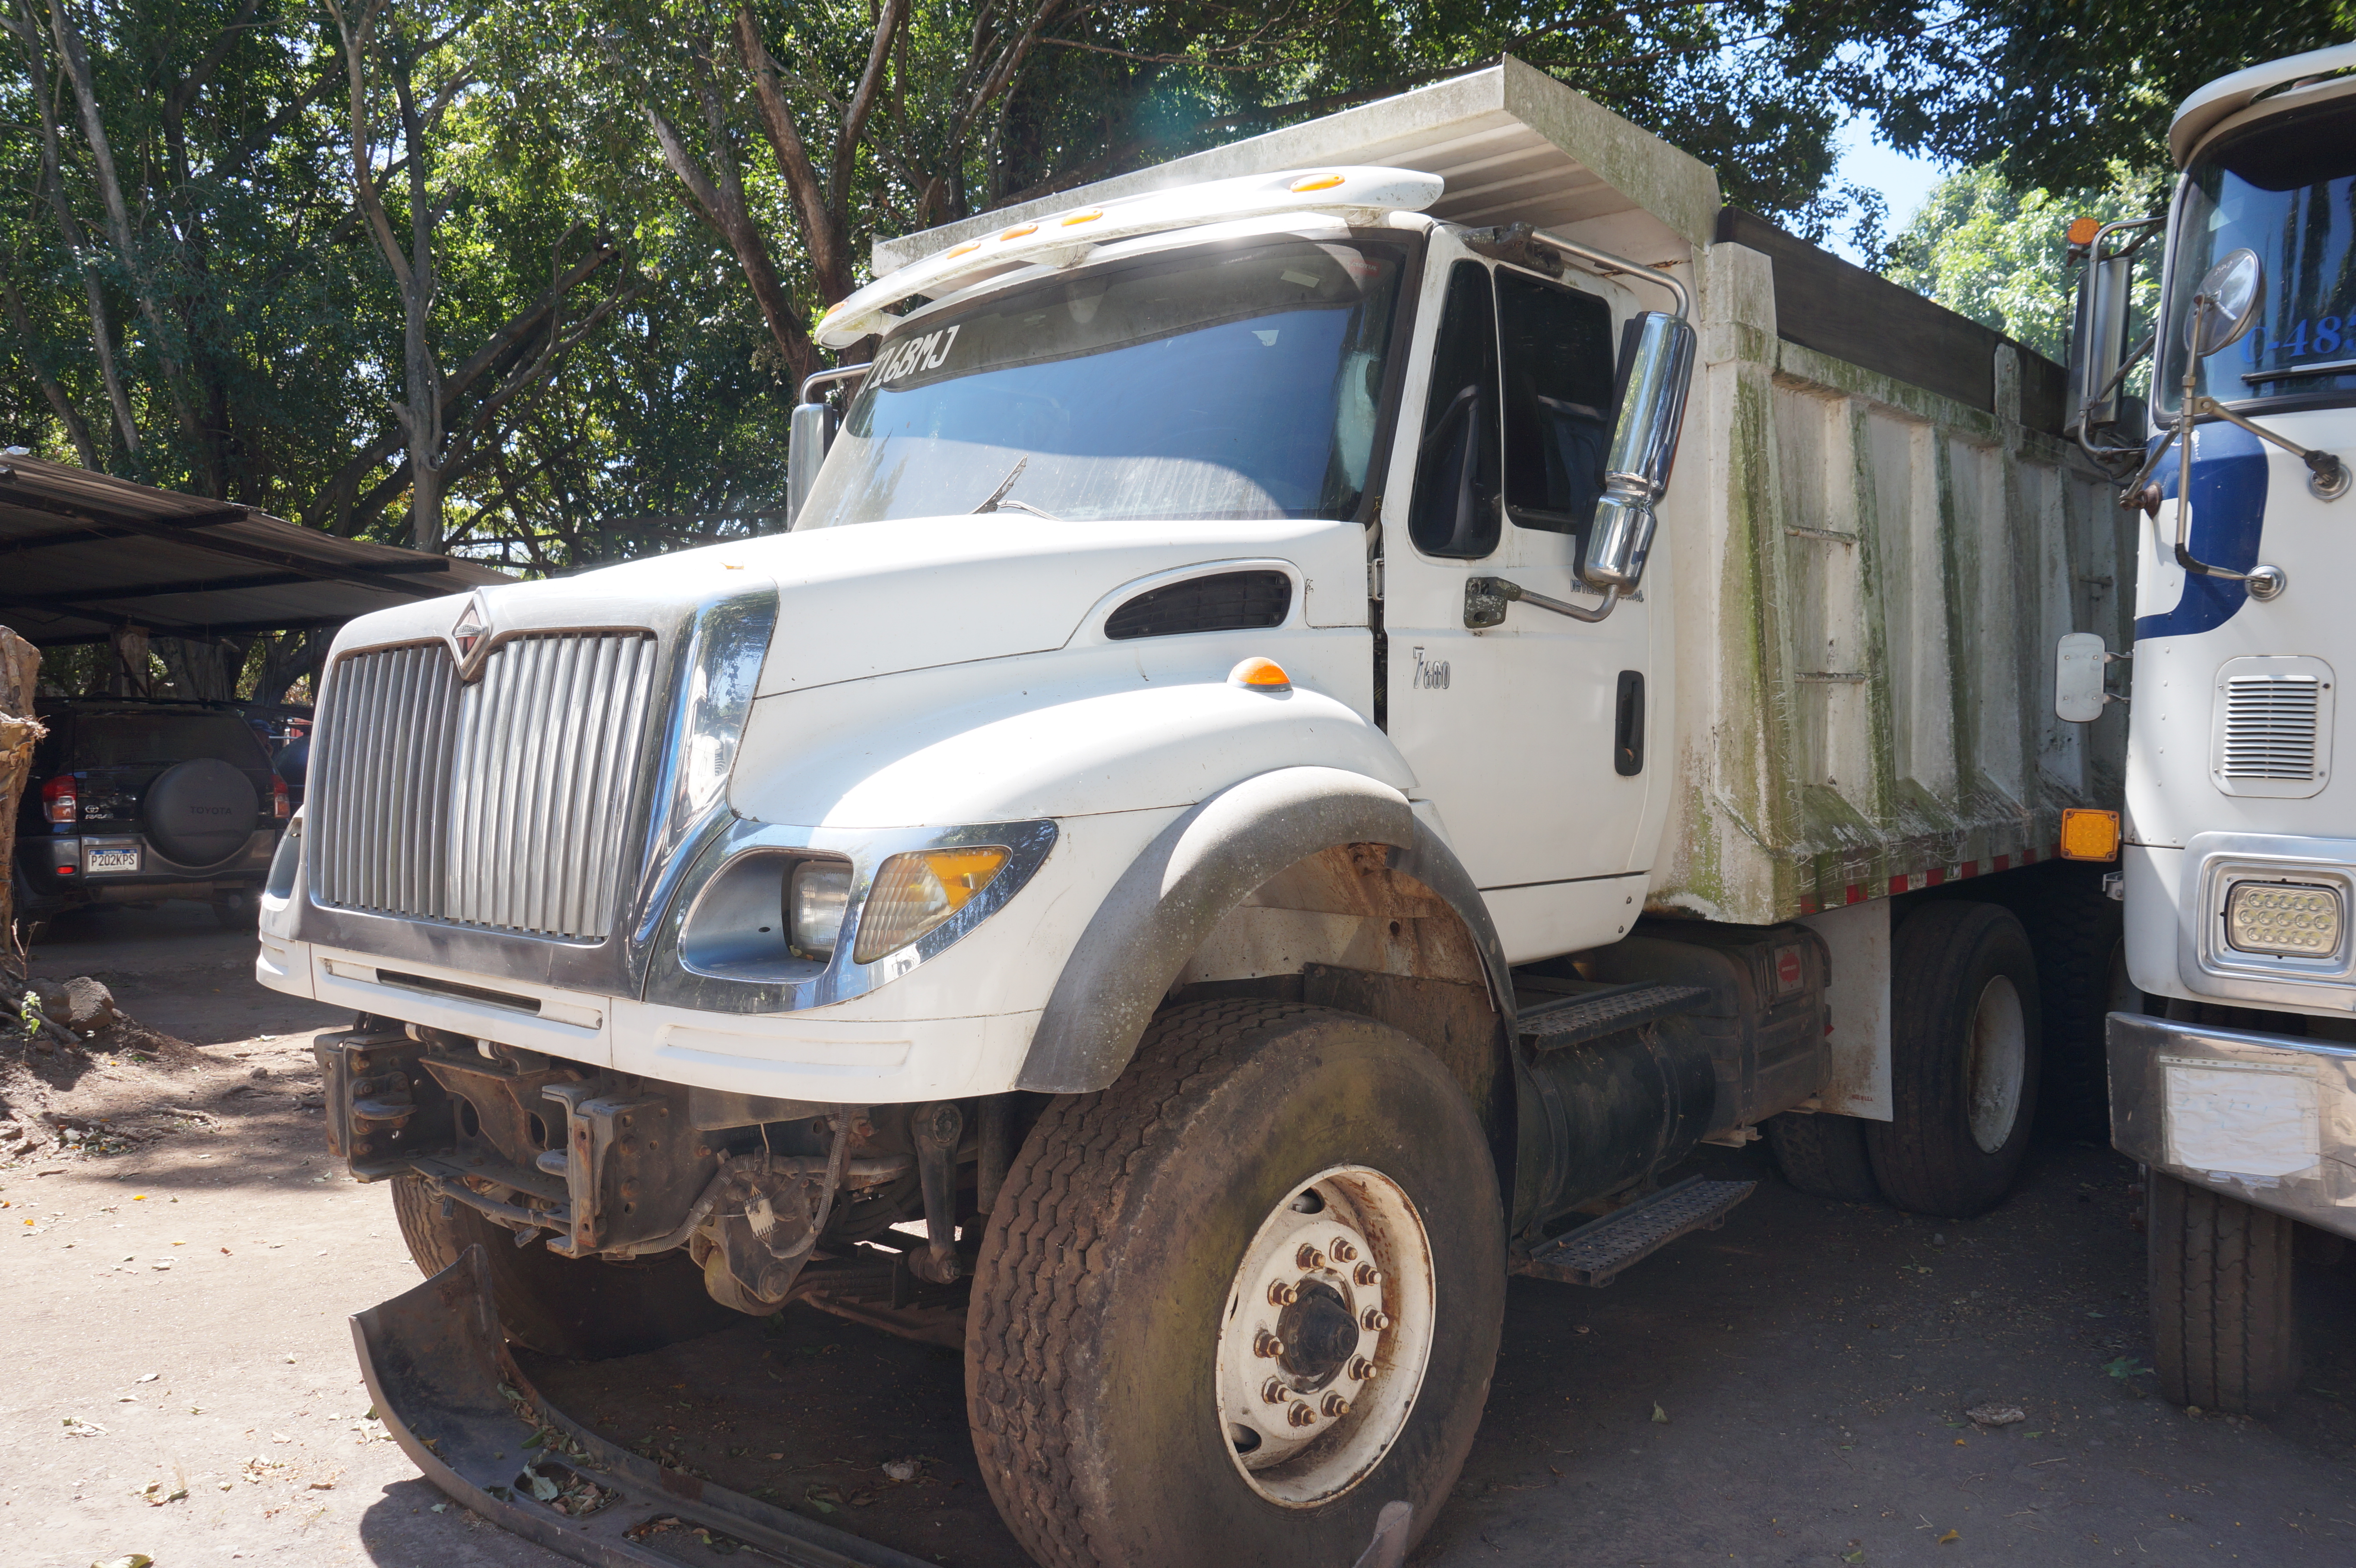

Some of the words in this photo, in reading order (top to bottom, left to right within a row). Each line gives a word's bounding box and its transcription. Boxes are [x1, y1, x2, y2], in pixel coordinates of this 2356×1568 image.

[1350, 262, 1377, 271] MOTUL
[855, 325, 960, 399] 716BMJ
[1413, 647, 1450, 689] 7600
[190, 806, 232, 815] TOYOTA
[92, 854, 135, 866] P202KPS
